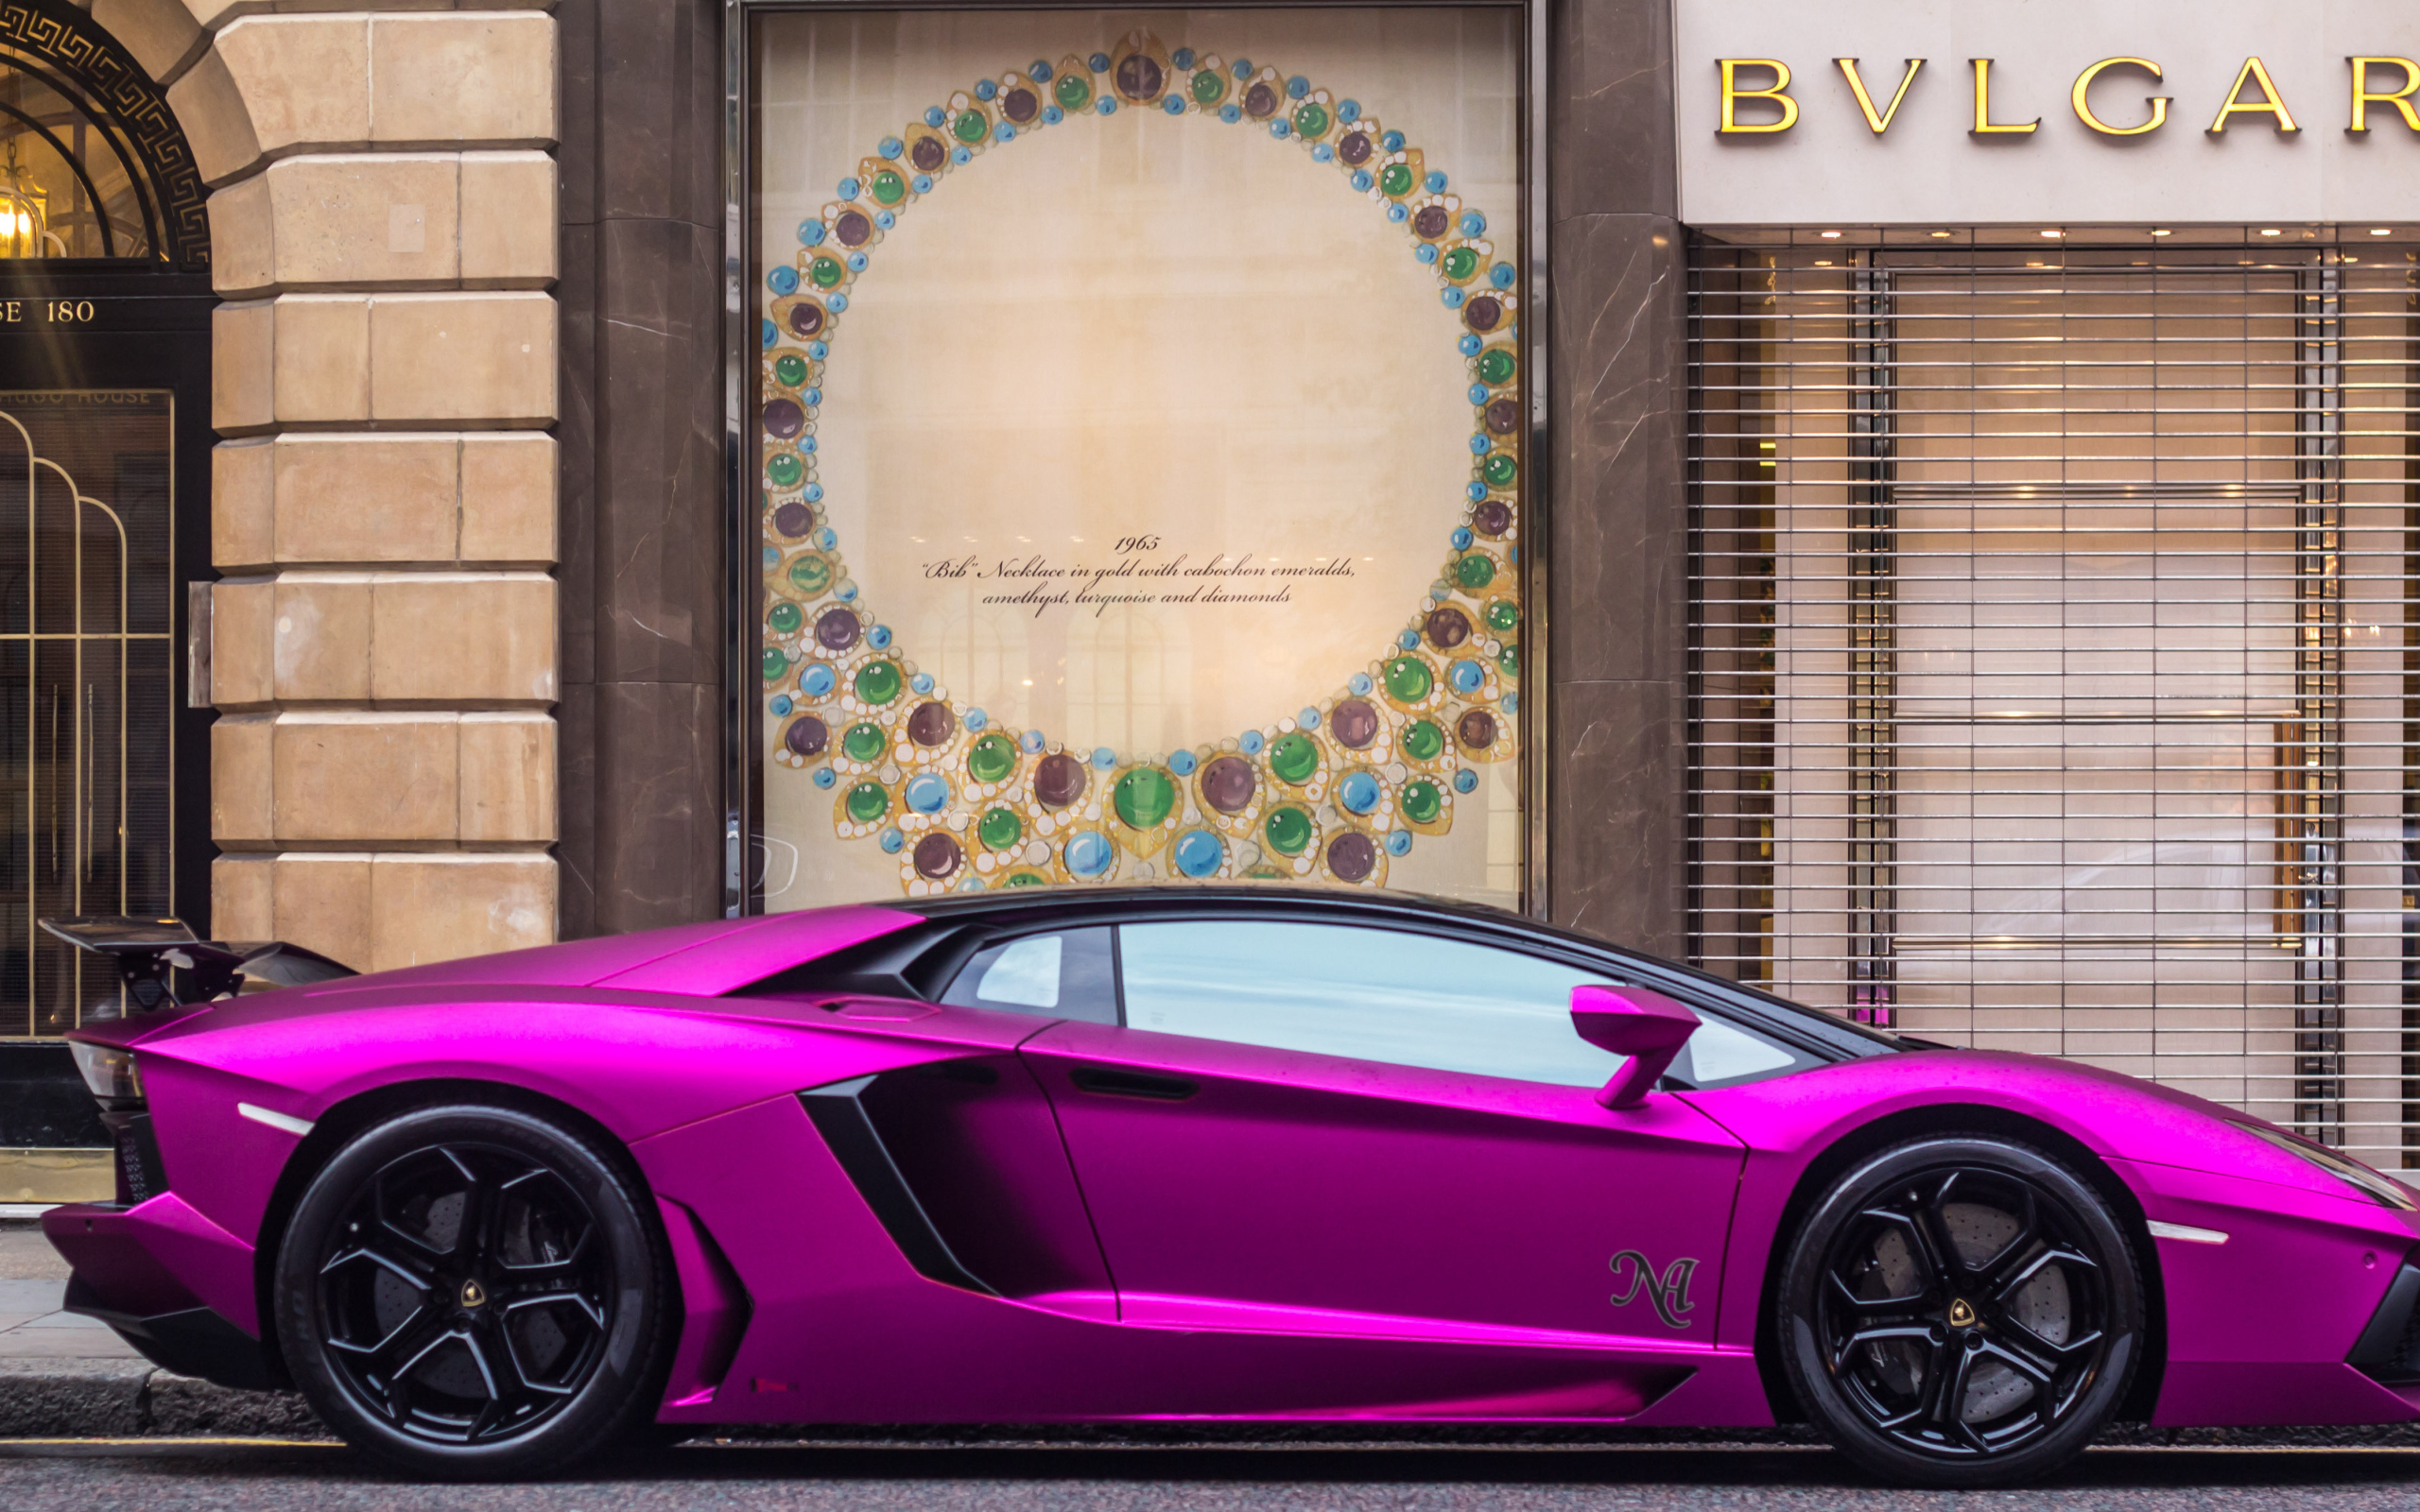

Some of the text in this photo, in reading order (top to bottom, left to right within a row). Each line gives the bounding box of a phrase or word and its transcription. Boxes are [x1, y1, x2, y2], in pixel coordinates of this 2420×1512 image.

[1715, 56, 2420, 136] BVLGAR
[48, 301, 95, 322] 180
[78, 392, 150, 404] HOUSE
[1114, 534, 1162, 555] 1965
[977, 555, 1065, 578] Necklace
[1070, 563, 1091, 577] in
[1083, 558, 1141, 592] gold
[1138, 554, 1188, 576] with
[1184, 553, 1267, 576] cabochon
[1270, 558, 1356, 578] emeralds,
[982, 580, 1292, 618] amethyst, turquoise and diamonds
